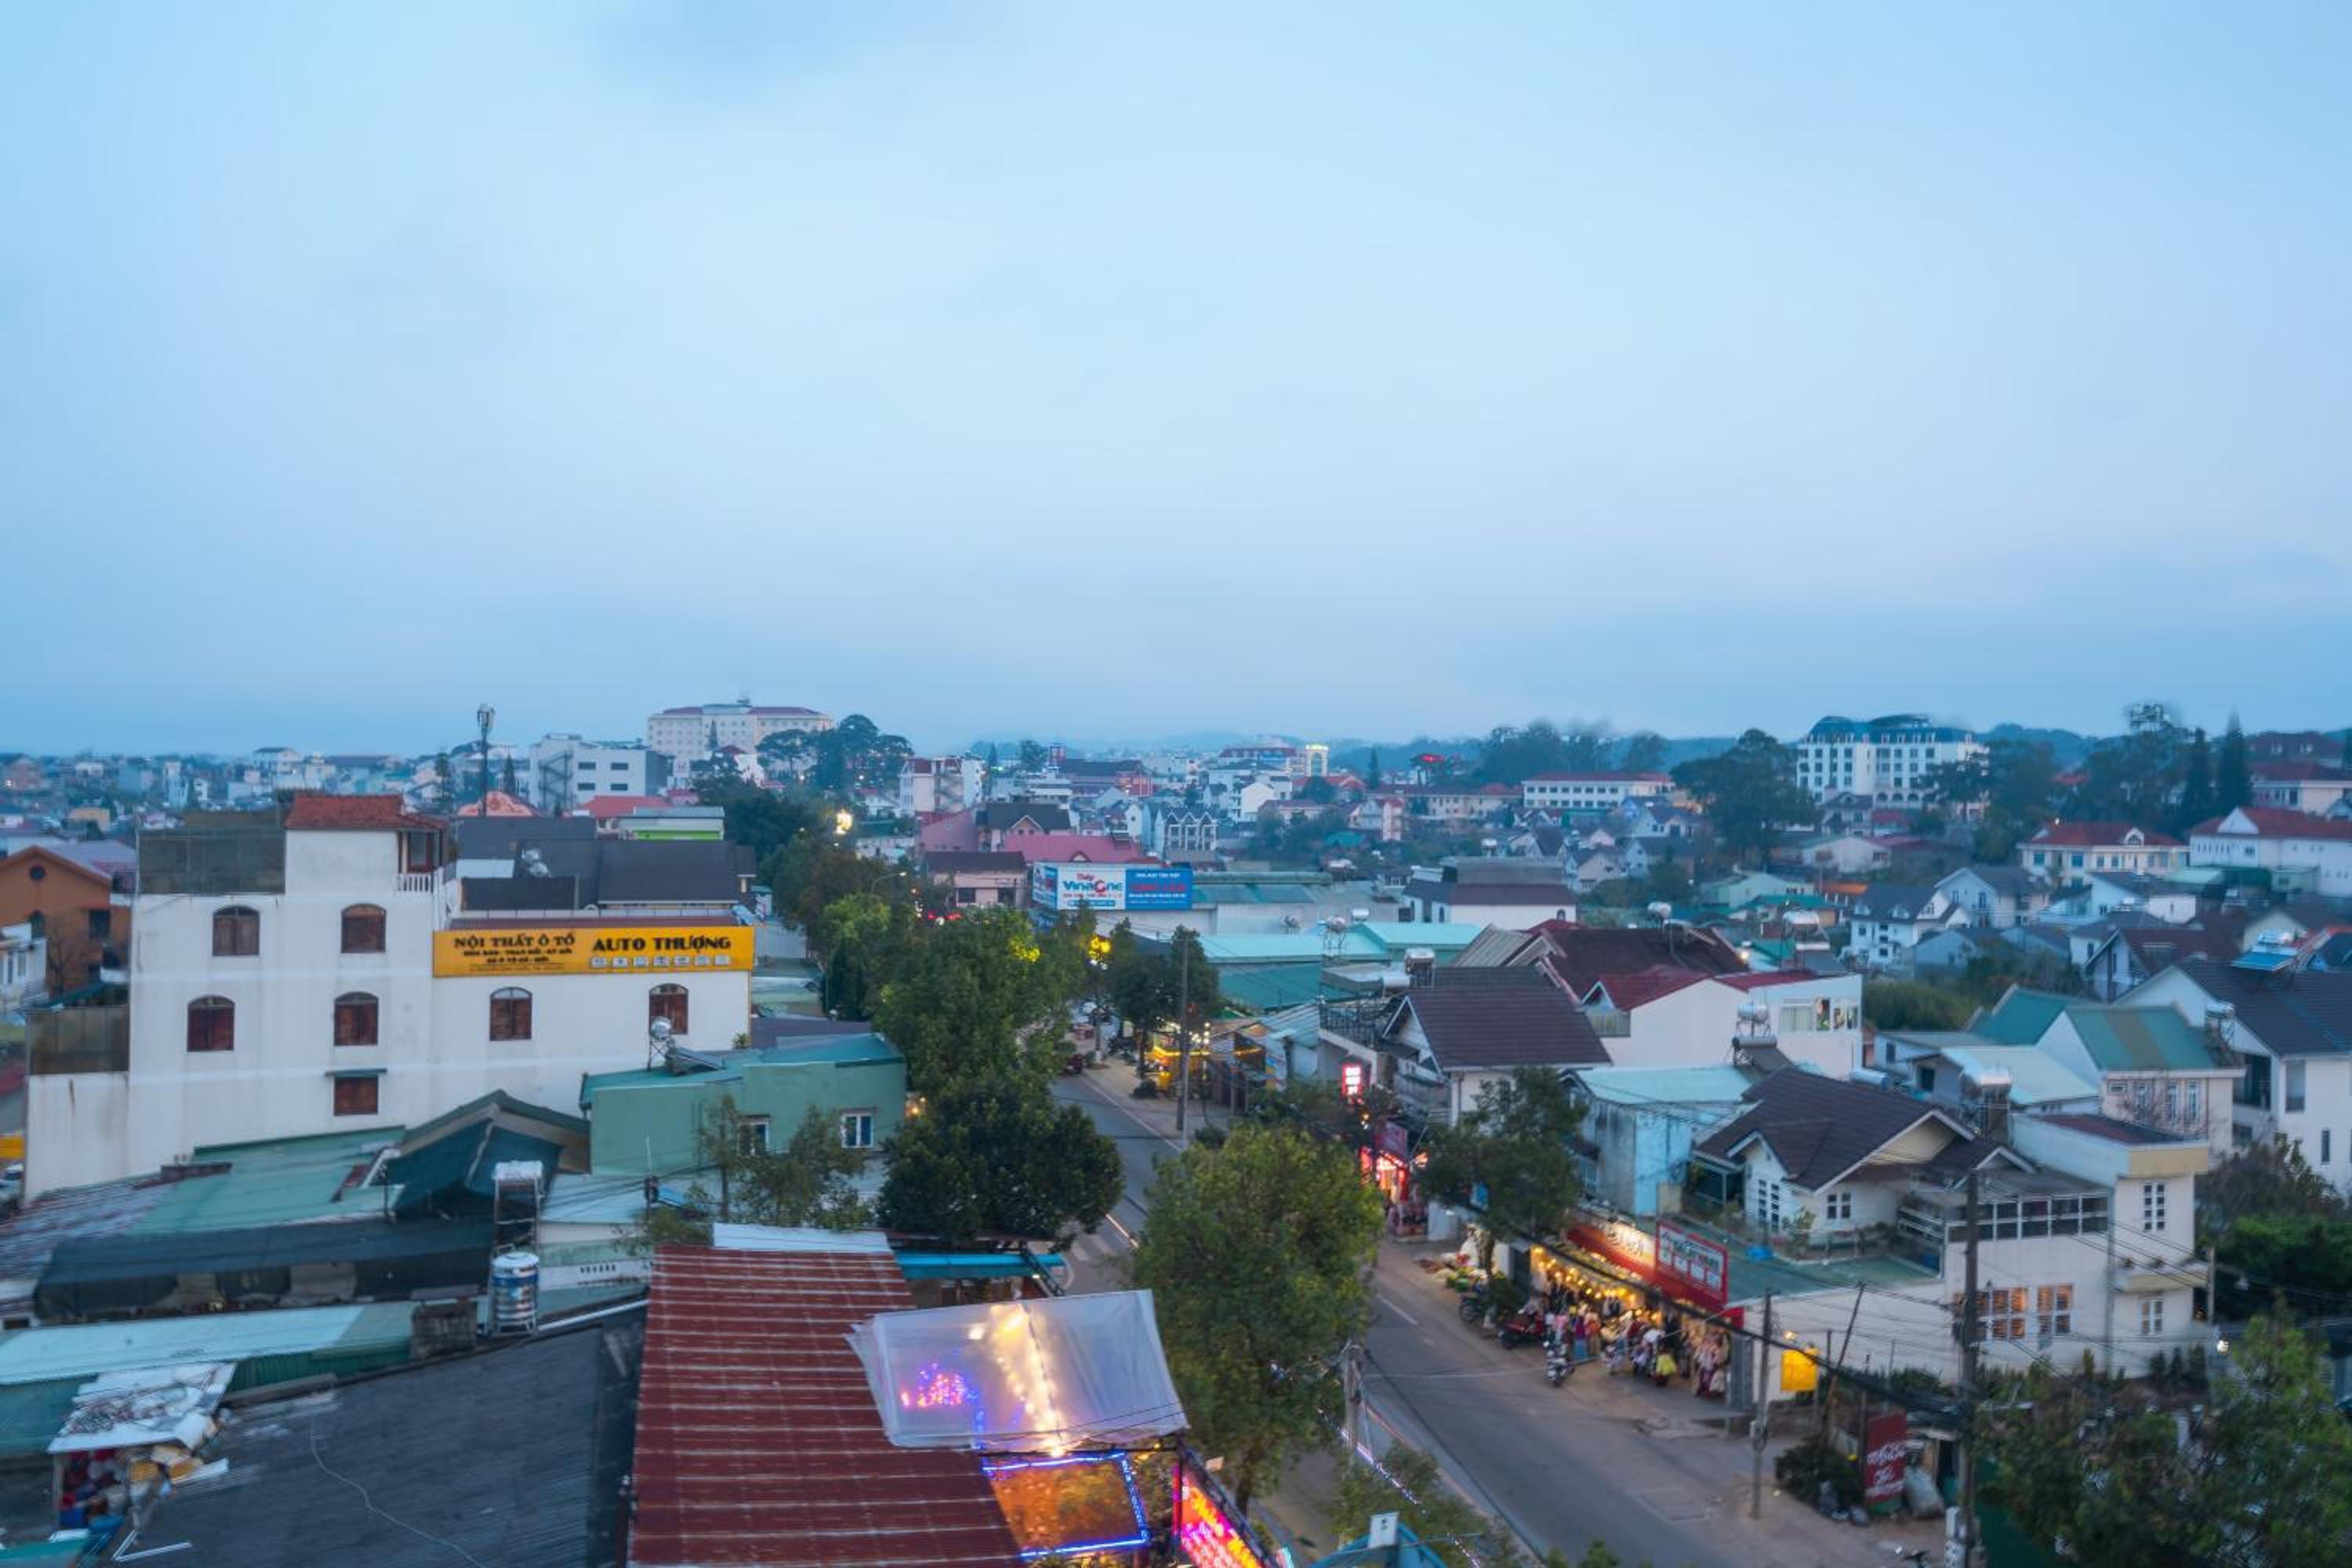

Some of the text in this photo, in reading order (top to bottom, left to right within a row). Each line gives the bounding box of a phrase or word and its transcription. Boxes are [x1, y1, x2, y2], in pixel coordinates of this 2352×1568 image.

[454, 935, 485, 949] NỘI
[490, 933, 534, 947] THẤT
[539, 934, 550, 946] Ô
[591, 935, 731, 953] AUTO THƯỢNG
